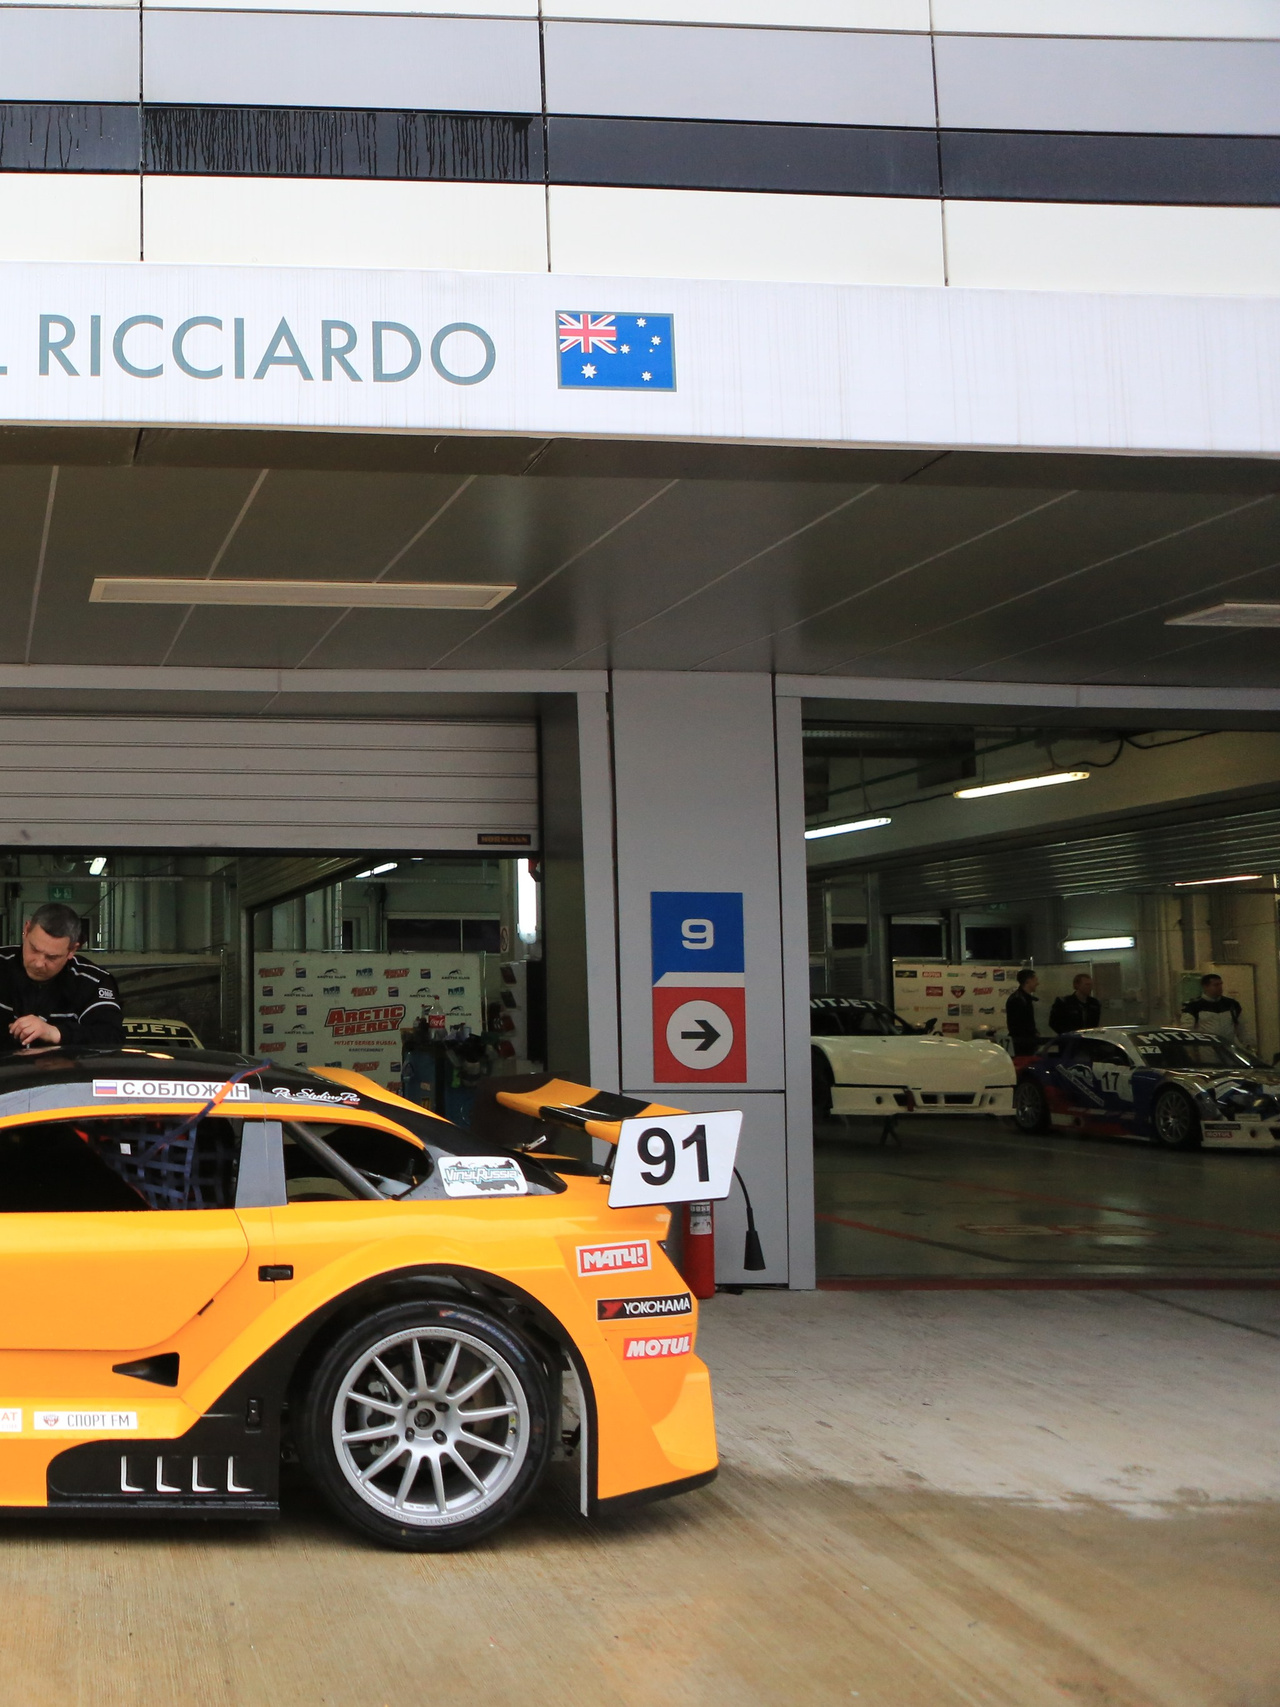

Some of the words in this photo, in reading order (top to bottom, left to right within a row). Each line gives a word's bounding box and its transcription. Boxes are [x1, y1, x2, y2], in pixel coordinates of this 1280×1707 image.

[38, 314, 497, 386] RICCIARDO
[681, 918, 714, 950] 9
[326, 1006, 404, 1025] ARCTIC
[122, 1023, 180, 1035] TJET
[333, 1020, 401, 1035] ENERGY
[1136, 1031, 1222, 1044] MITJET
[1102, 1071, 1120, 1091] 17
[637, 1124, 710, 1186] 91
[623, 1297, 691, 1315] YOKOHAMA
[625, 1335, 690, 1358] MOTUL
[67, 1414, 107, 1427] СПОРТ
[111, 1414, 130, 1427] FM
